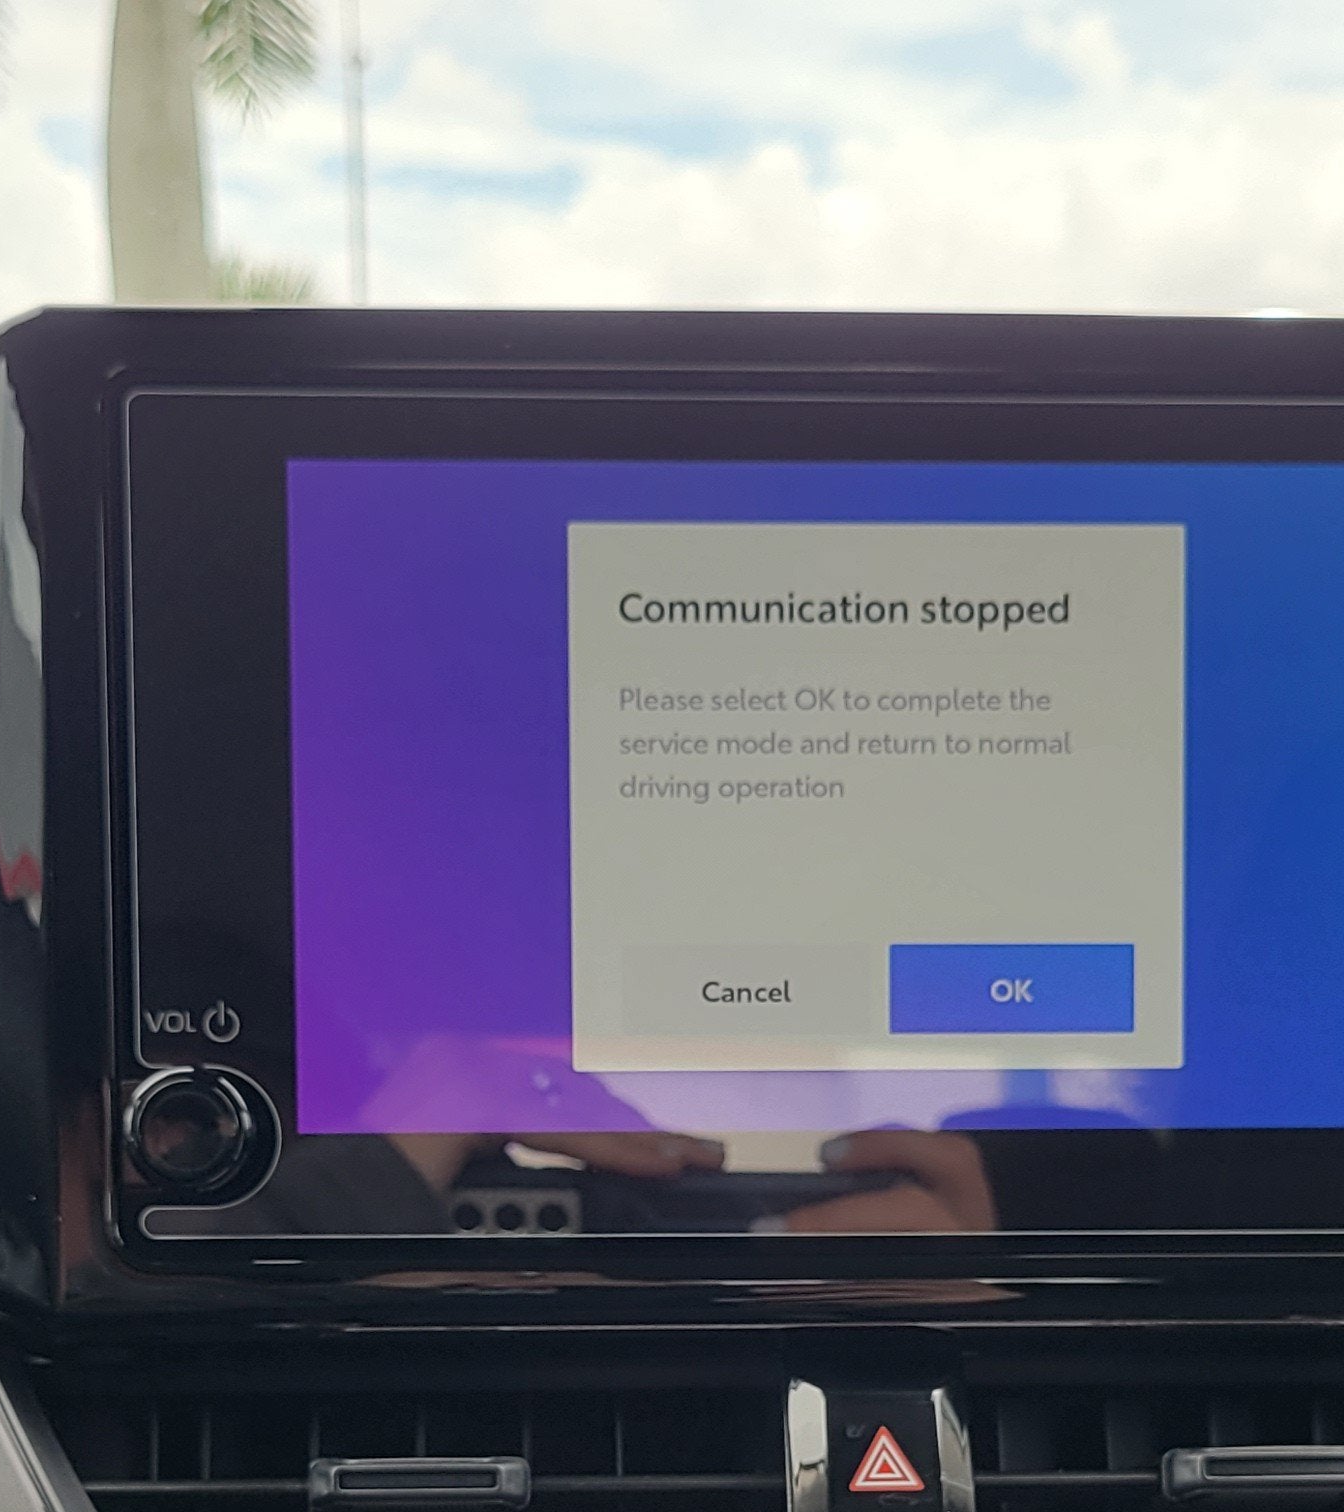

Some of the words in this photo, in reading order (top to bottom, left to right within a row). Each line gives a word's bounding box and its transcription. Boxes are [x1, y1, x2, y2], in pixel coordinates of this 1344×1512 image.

[618, 592, 909, 625] Communication
[920, 593, 1071, 631] stopped
[619, 687, 704, 712] Please
[711, 688, 787, 712] select
[795, 689, 836, 712] OK
[843, 691, 870, 712] to
[877, 687, 1003, 718] complete
[1009, 687, 1052, 712] the
[619, 733, 709, 756] service
[717, 732, 793, 756] mode
[800, 732, 850, 756] and
[857, 734, 936, 756] return
[945, 735, 971, 756] to
[978, 731, 1071, 756] normal
[619, 775, 709, 804] driving
[718, 774, 844, 804] operation
[701, 980, 792, 1003] Cancel
[989, 978, 1034, 1002] OK
[144, 1010, 197, 1033] VOL
